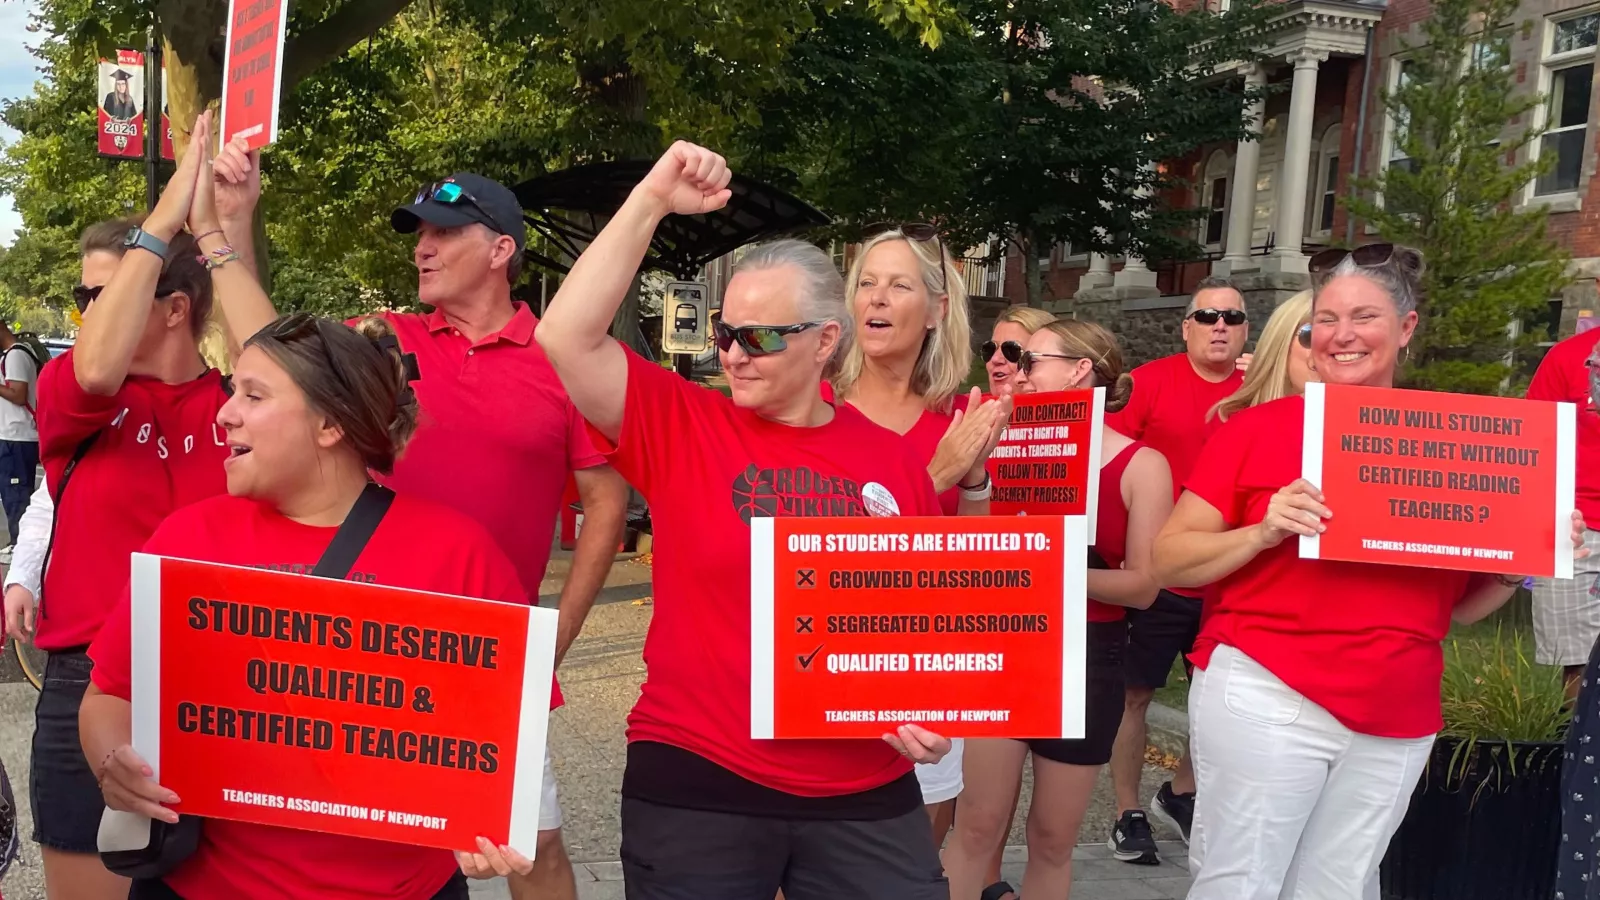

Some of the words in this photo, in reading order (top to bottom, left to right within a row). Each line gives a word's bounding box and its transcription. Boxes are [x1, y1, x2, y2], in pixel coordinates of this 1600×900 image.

[104, 121, 137, 136] 2024
[1016, 405, 1034, 422] OUR
[1036, 401, 1087, 421] CONTRACT!
[1359, 406, 1400, 426] HOW
[1404, 409, 1444, 430] WILL
[1448, 413, 1523, 436] STUDENT
[1008, 427, 1033, 441] WHAT'S
[1034, 426, 1055, 440] RIGHT
[1055, 426, 1069, 439] FOR
[1021, 446, 1027, 458] &
[1028, 444, 1062, 457] TEACHERS
[1062, 443, 1077, 457] AND
[1341, 434, 1394, 455] NEEDS
[1398, 438, 1419, 457] BE
[1423, 440, 1457, 460] MET
[1461, 443, 1539, 467] WITHOUT
[997, 464, 1031, 480] FOLLOW
[1032, 463, 1049, 480] THE
[1049, 463, 1067, 479] JOB
[1359, 465, 1443, 489] CERTIFIED
[1448, 471, 1520, 495] READING
[1034, 486, 1079, 503] PROCESS!
[1388, 498, 1474, 523] TEACHERS
[1478, 505, 1490, 523] ?
[787, 533, 822, 552] OUR
[825, 533, 910, 552] STUDENTS
[912, 533, 943, 551] ARE
[947, 533, 1021, 551] ENTITLED
[1024, 532, 1051, 551] TO:
[1362, 539, 1404, 551] TEACHERS
[1405, 542, 1460, 556] ASSOCIATION
[1462, 547, 1472, 557] OF
[1473, 548, 1514, 560] NEWPORT
[829, 570, 913, 589] CROWDED
[917, 569, 1031, 588] CLASSROOMS
[187, 597, 353, 649] STUDENTS
[361, 620, 499, 669] DESERVE
[827, 615, 930, 633] SEGREGATED
[934, 614, 1048, 632] CLASSROOMS
[826, 653, 910, 673] QUALIFIED
[913, 653, 1004, 672] TEACHERS!
[246, 659, 404, 709] QUALIFIED
[412, 686, 435, 713] &
[825, 710, 875, 722] TEACHERS
[877, 710, 944, 722] ASSOCIATION
[946, 710, 959, 721] OF
[960, 710, 1010, 722] NEWPORT
[177, 701, 333, 751] CERTIFIED
[341, 723, 499, 774] TEACHERS
[222, 788, 285, 809] TEACHERS
[286, 797, 368, 820] ASSOCIATION
[370, 808, 386, 823] OF
[388, 810, 448, 831] NEWPORT
